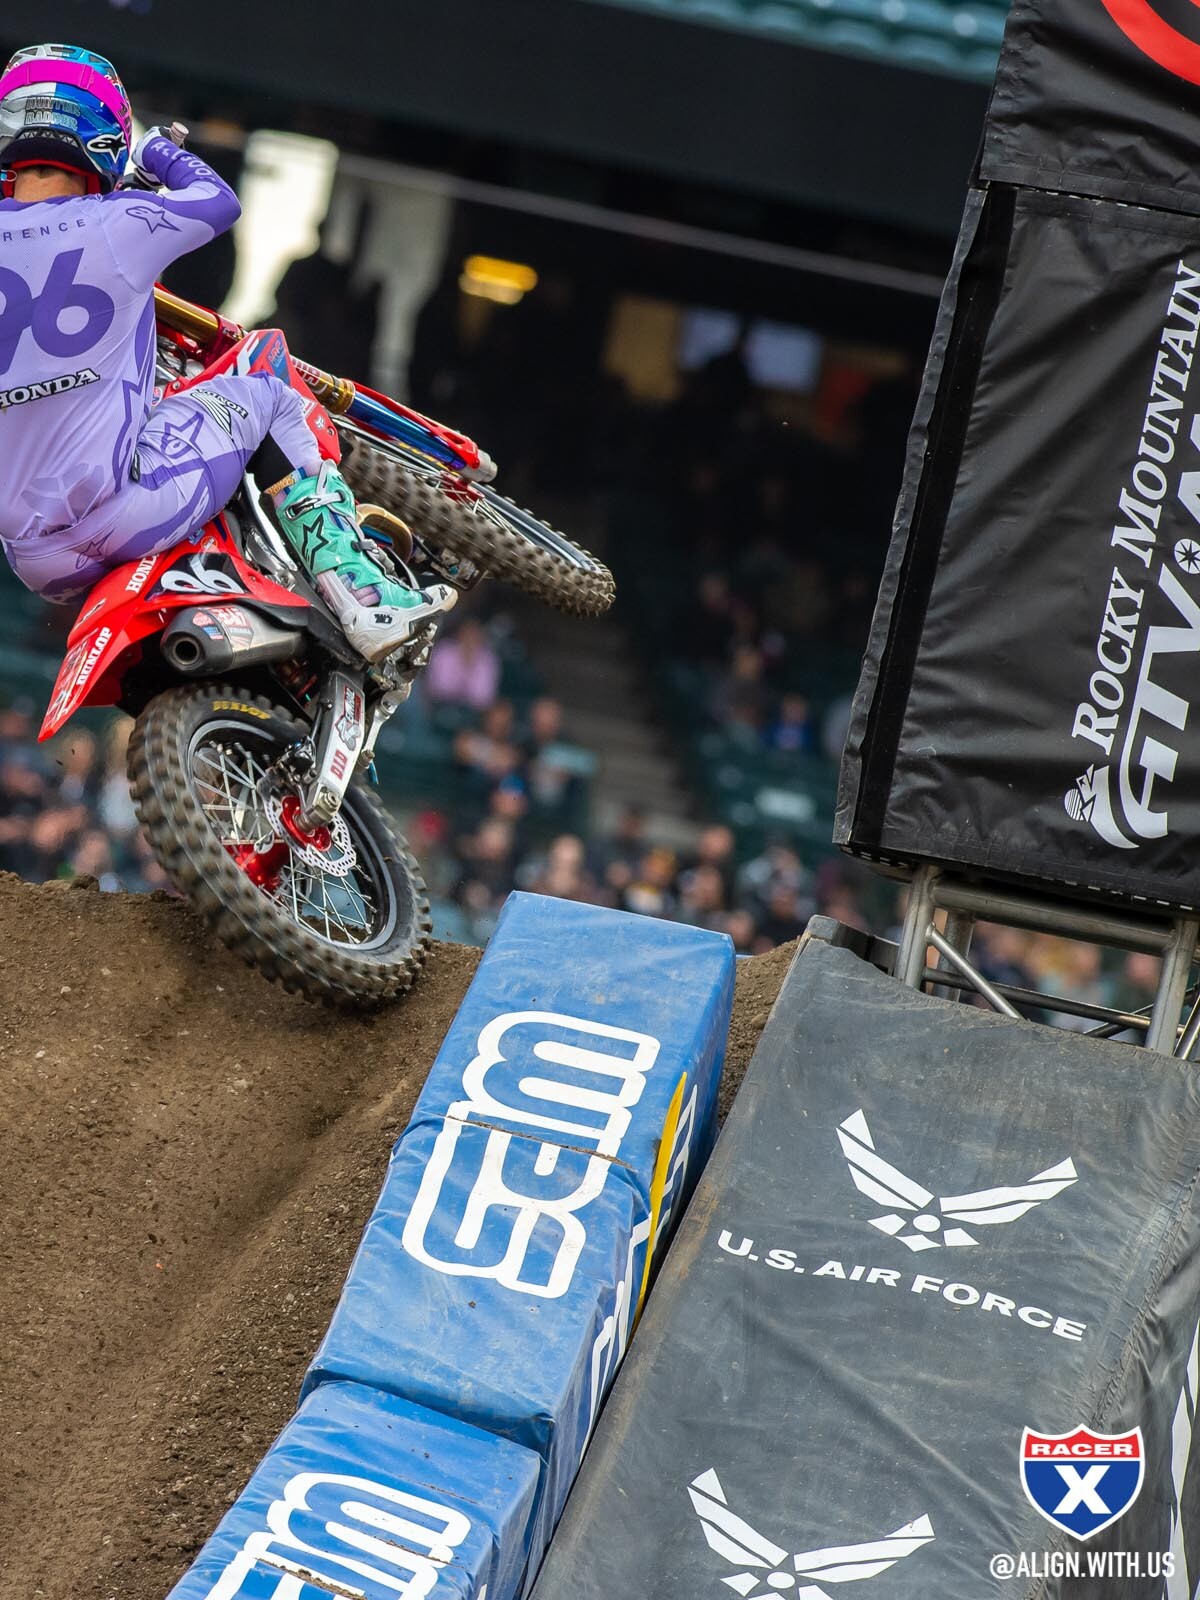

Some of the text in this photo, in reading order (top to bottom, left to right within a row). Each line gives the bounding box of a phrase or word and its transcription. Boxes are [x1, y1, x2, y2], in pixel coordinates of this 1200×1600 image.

[1071, 259, 1200, 756] ROCKY MOUNTAIN
[76, 626, 113, 686] DUNLOP
[717, 1229, 1087, 1342] U.S. AIR FORCE
